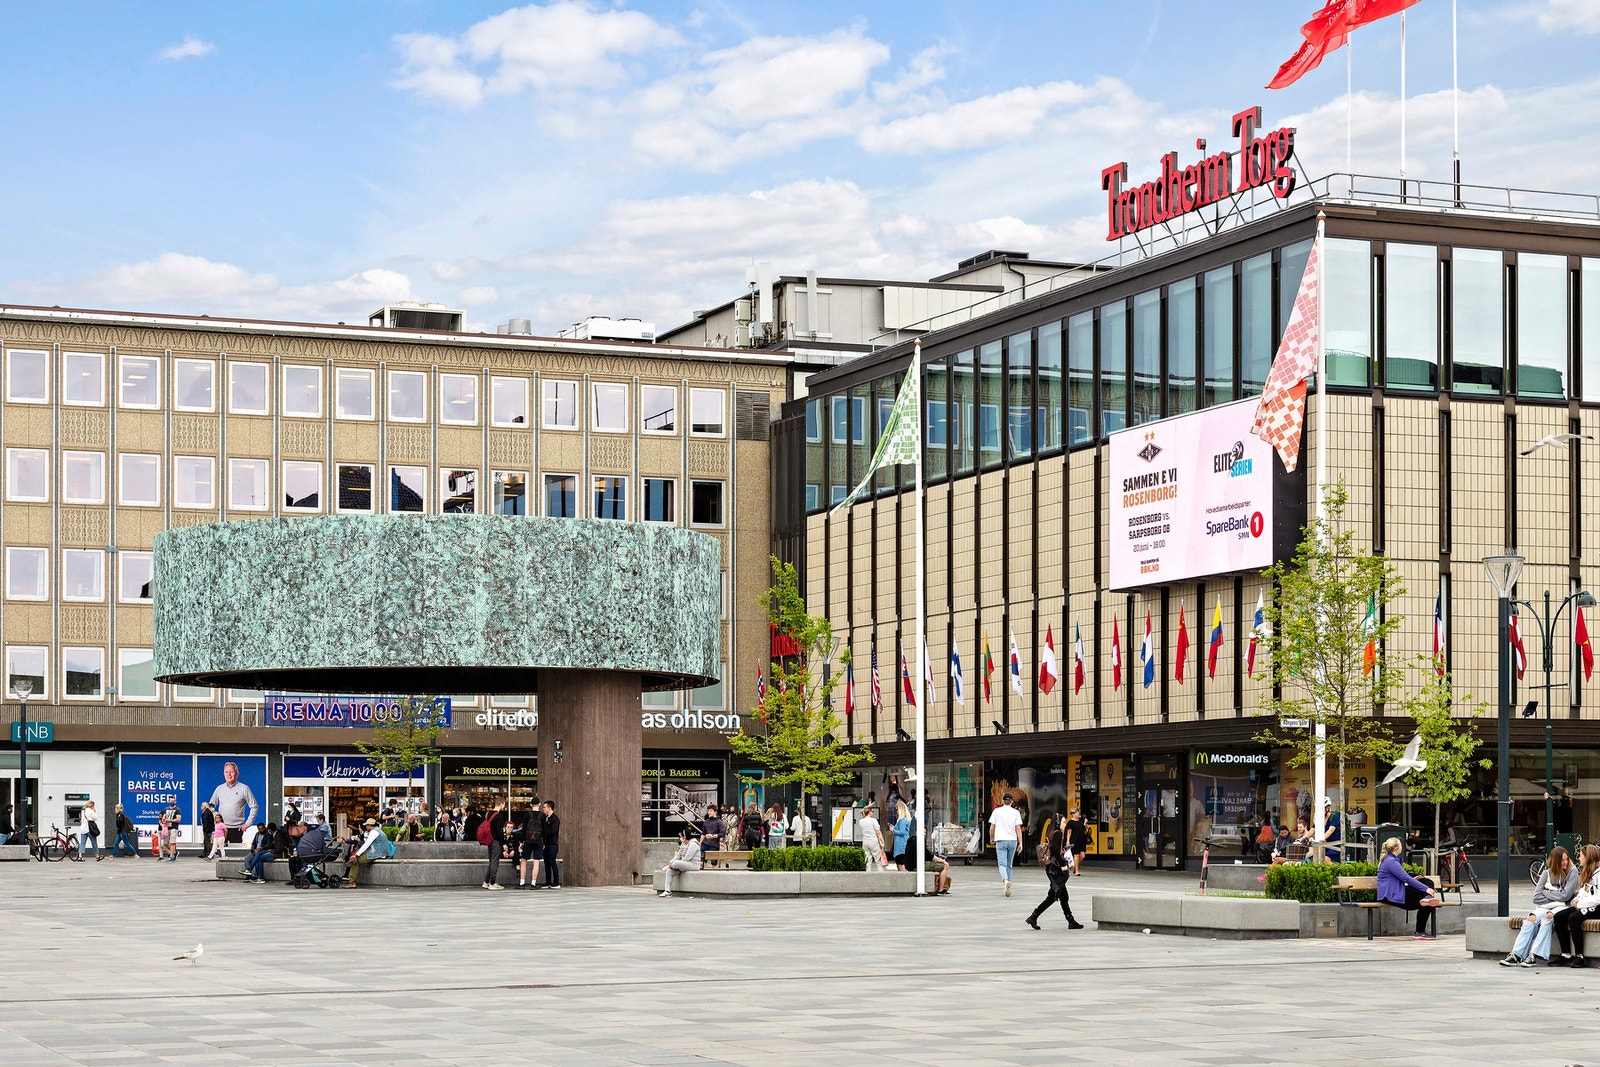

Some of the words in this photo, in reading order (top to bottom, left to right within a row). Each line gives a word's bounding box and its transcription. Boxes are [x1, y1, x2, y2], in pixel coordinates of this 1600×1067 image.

[1102, 138, 1232, 241] Trondheim
[1232, 106, 1297, 198] Torg
[1213, 452, 1232, 473] ELITE
[1231, 458, 1252, 478] SERIEN
[1123, 472, 1159, 492] SAMMEN
[1161, 470, 1167, 484] E
[1168, 468, 1177, 482] VI
[1123, 484, 1177, 508] ROSENBORG!
[1128, 512, 1161, 527] ROSENBORG
[1206, 515, 1249, 537] SpareBank
[1128, 525, 1162, 540] SARPSBORG
[272, 701, 344, 721] REMA
[348, 702, 403, 722] 1000
[475, 708, 538, 727] elitefo
[641, 713, 667, 728] as
[670, 708, 740, 729] ohlson
[1210, 754, 1269, 764] McDonald's
[149, 771, 159, 779] gir
[160, 771, 174, 779] deg
[462, 766, 516, 775] ROSENBORG
[520, 767, 538, 776] BAG
[641, 769, 666, 777] BORG
[669, 768, 701, 777] BAGERI
[128, 780, 156, 790] BARE
[158, 780, 186, 790] LAVE
[1352, 776, 1368, 789] 29
